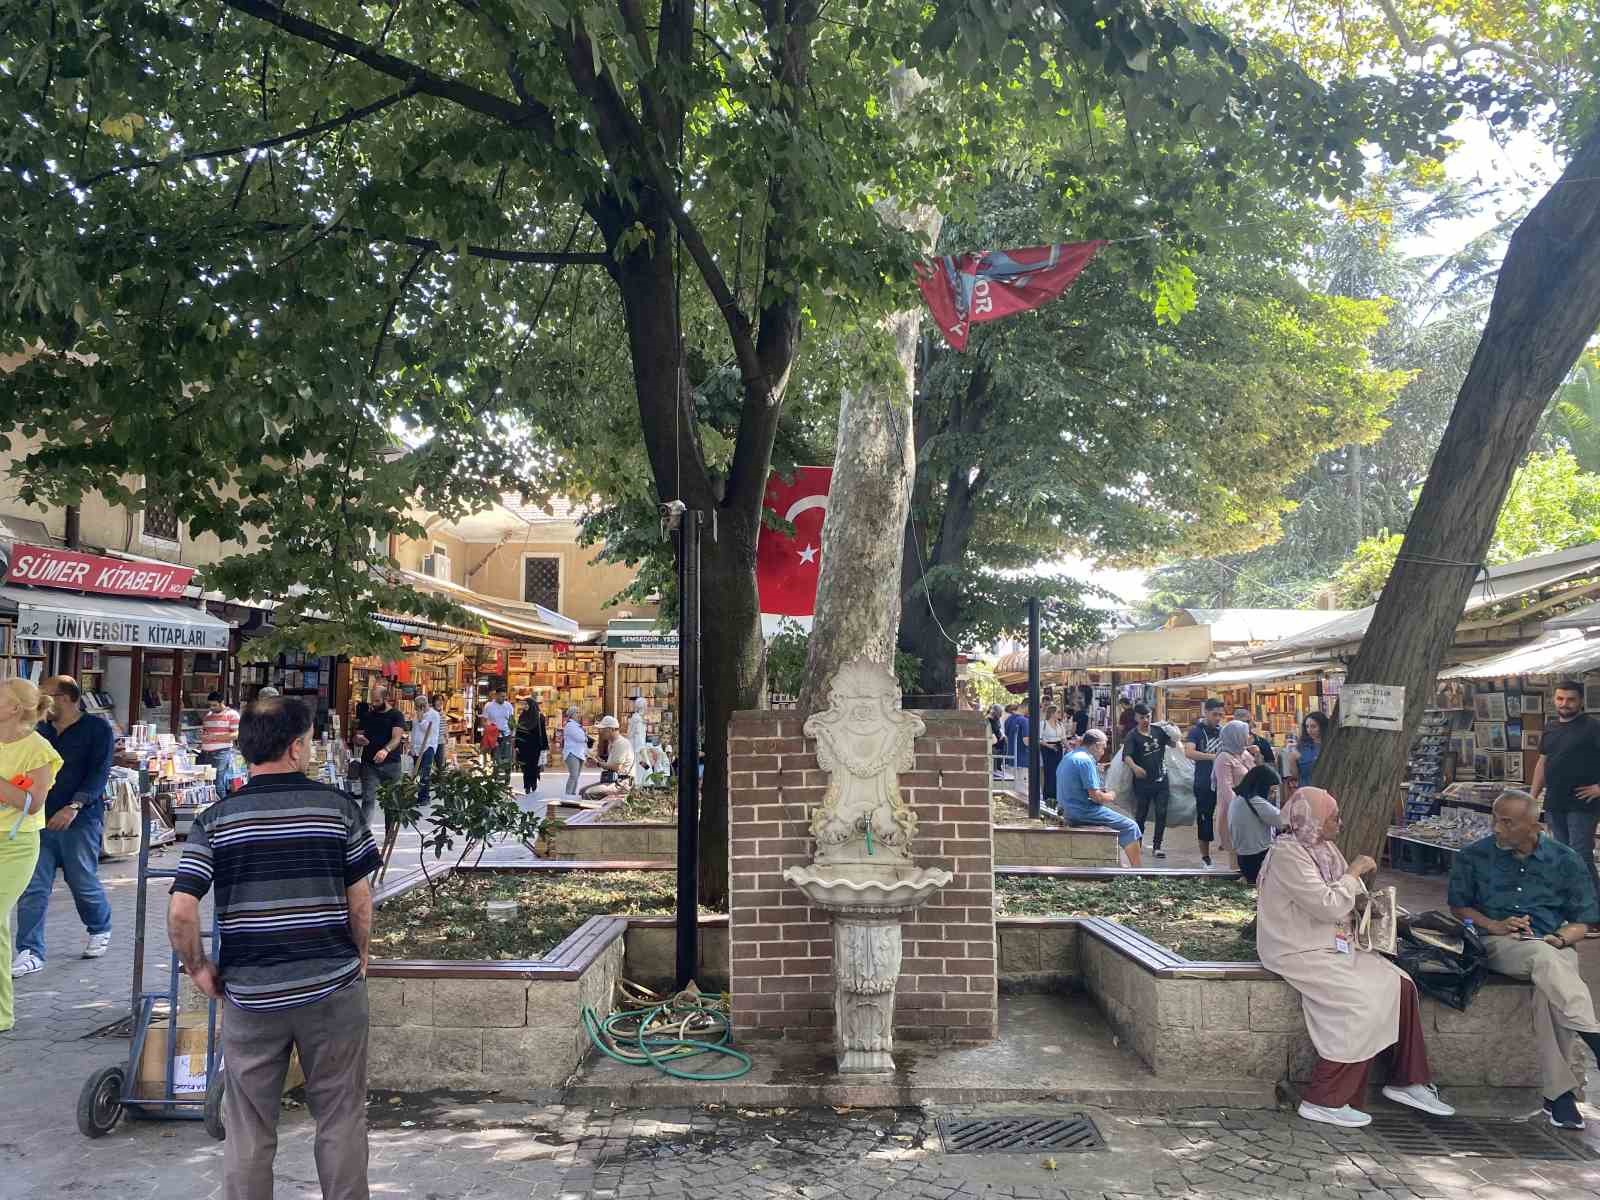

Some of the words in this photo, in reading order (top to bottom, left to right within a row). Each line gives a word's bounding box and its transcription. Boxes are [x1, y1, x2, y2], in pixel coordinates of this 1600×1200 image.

[12, 553, 90, 584] SÜMER
[95, 564, 174, 593] KİTABEVİ
[148, 624, 206, 647] KİTAPLARI
